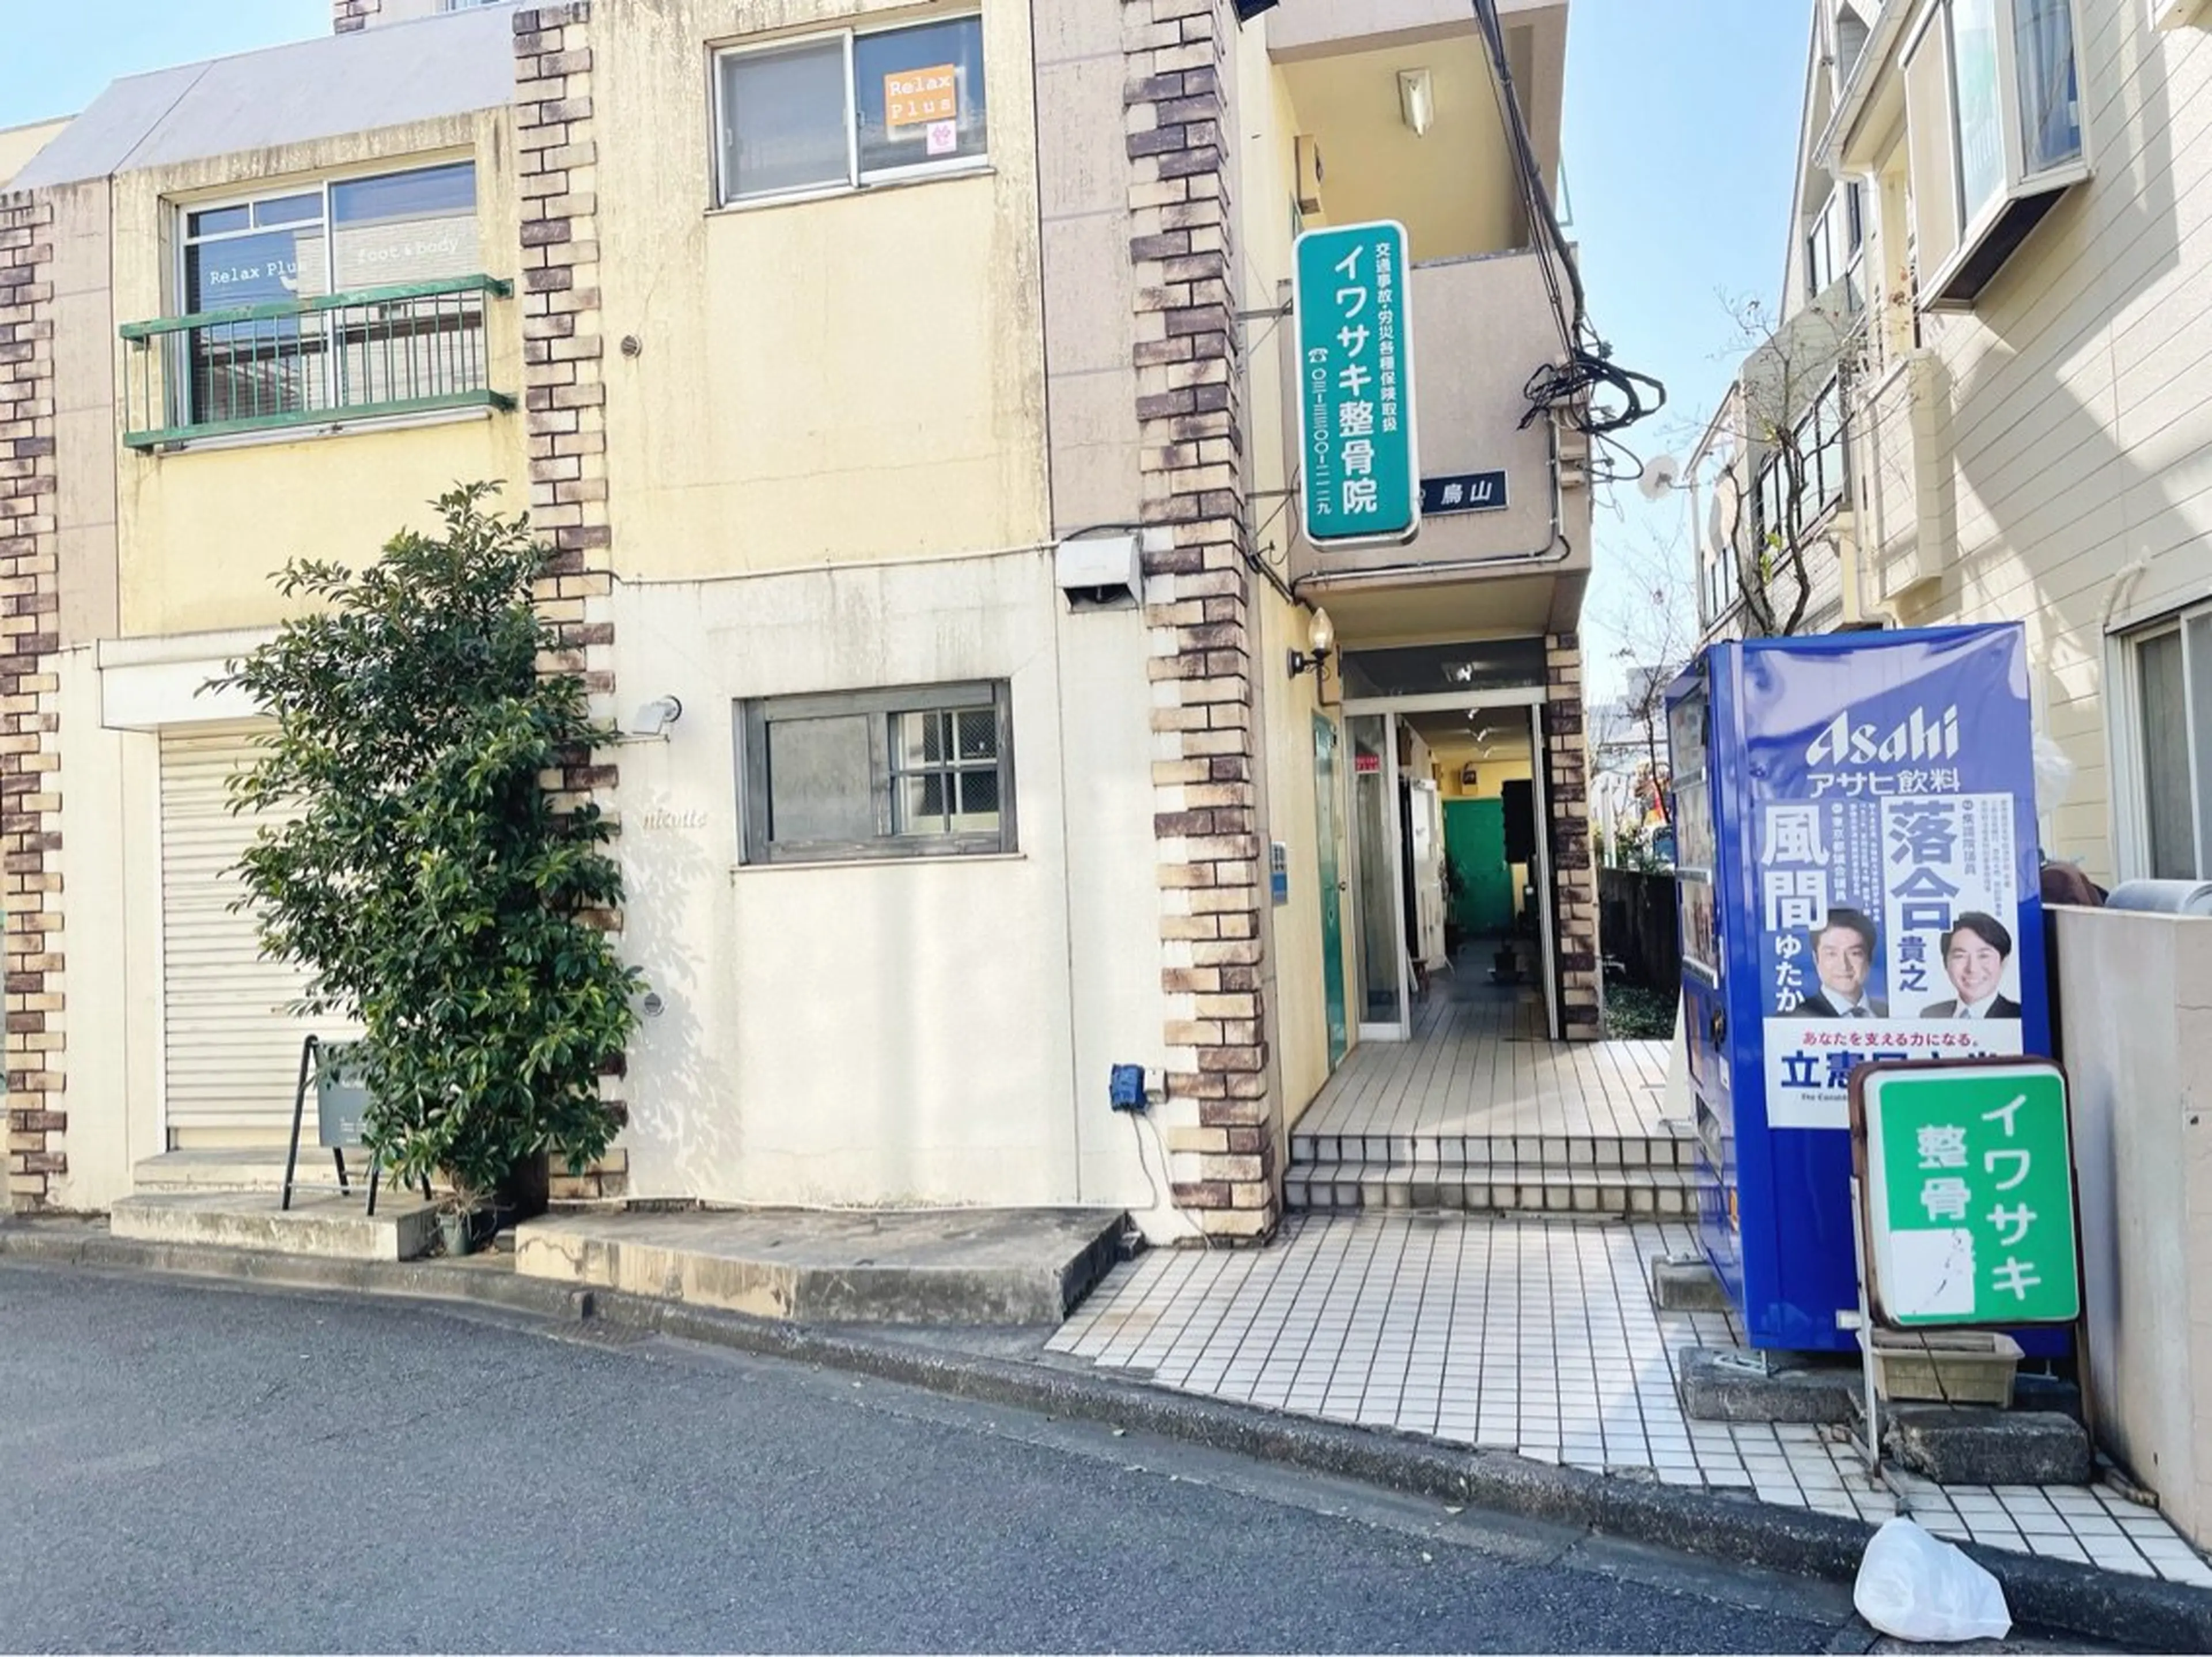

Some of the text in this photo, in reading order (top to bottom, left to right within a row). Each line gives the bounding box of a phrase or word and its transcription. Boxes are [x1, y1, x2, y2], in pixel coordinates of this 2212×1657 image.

[889, 75, 952, 96] Relax
[891, 98, 952, 120] Plus
[210, 267, 260, 285] Relax
[1335, 245, 1377, 515] イワサキ整骨院
[1805, 704, 1959, 767] Asahi
[1806, 767, 1960, 798] アサヒ飲料
[1916, 1123, 1976, 1276] 整骨
[1980, 1094, 2041, 1300] イワサキ
